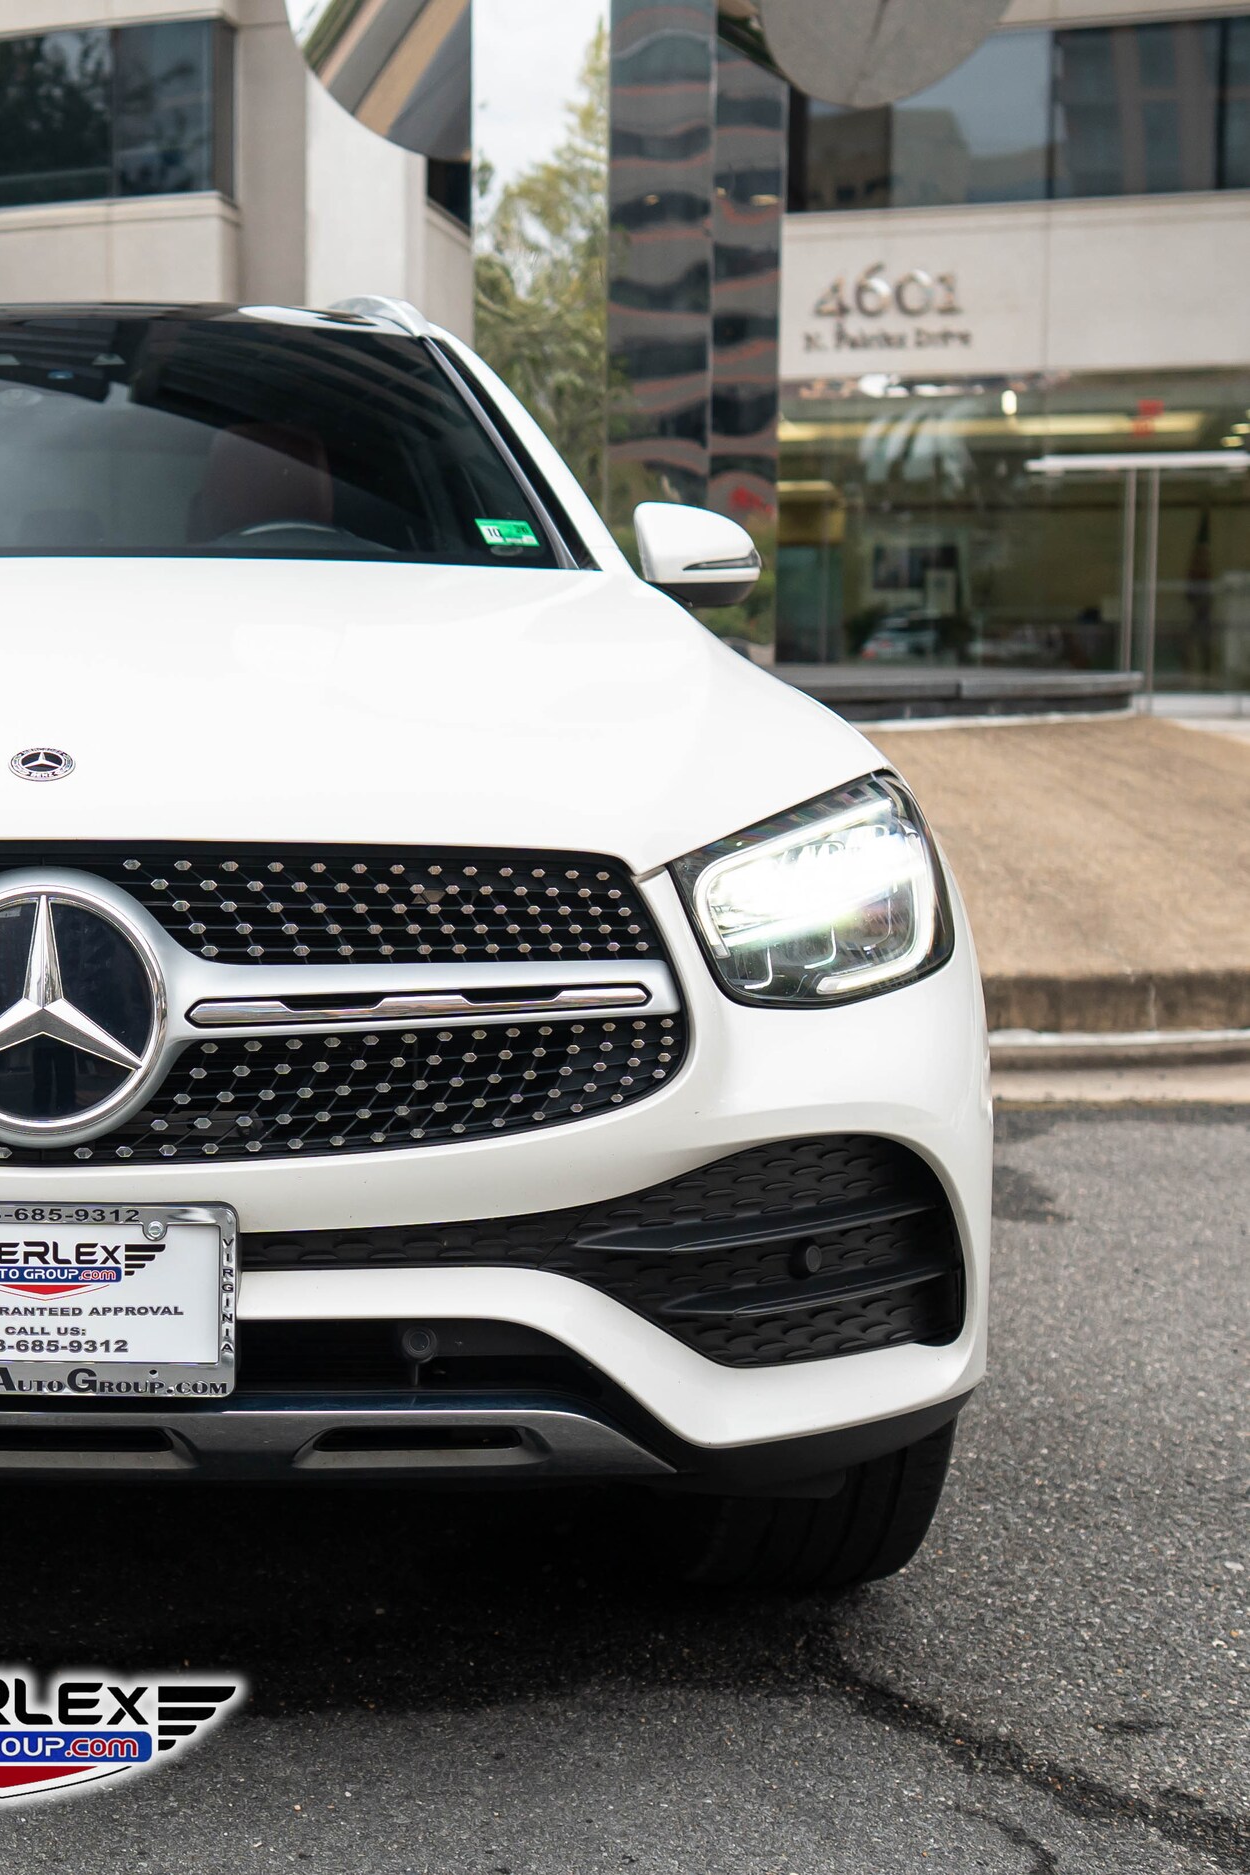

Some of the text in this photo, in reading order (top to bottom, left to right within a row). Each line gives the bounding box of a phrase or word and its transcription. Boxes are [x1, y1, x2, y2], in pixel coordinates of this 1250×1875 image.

[813, 261, 963, 319] 4601
[23, 1268, 117, 1281] GROUP.com
[221, 1238, 234, 1352] VIRGINIA
[88, 1306, 184, 1317] APPROVAL
[4, 1326, 86, 1337] CALL US:
